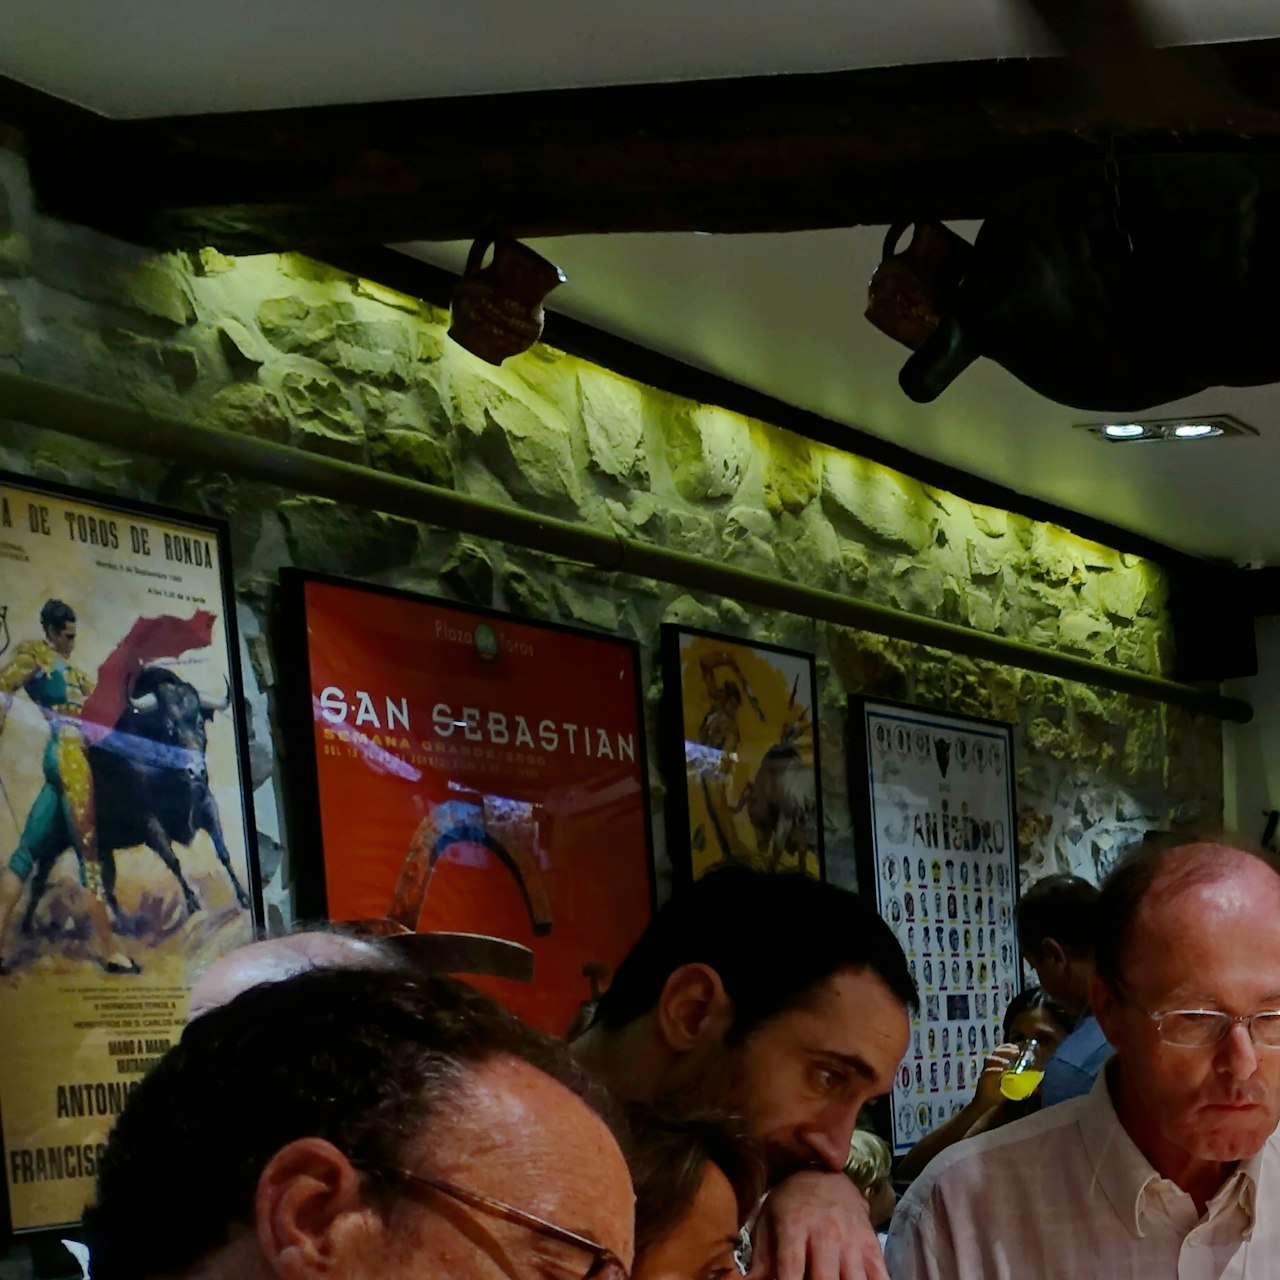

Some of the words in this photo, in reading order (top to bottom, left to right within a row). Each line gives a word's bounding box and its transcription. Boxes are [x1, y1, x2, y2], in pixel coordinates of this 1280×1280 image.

[28, 504, 51, 535] DE
[64, 511, 119, 549] TOROS
[130, 525, 151, 556] DE
[163, 533, 213, 569] RONDA
[434, 620, 473, 643] Plaza
[320, 686, 410, 732] SAN
[432, 703, 635, 763] SEBASTIAN
[323, 728, 410, 750] SEMANA
